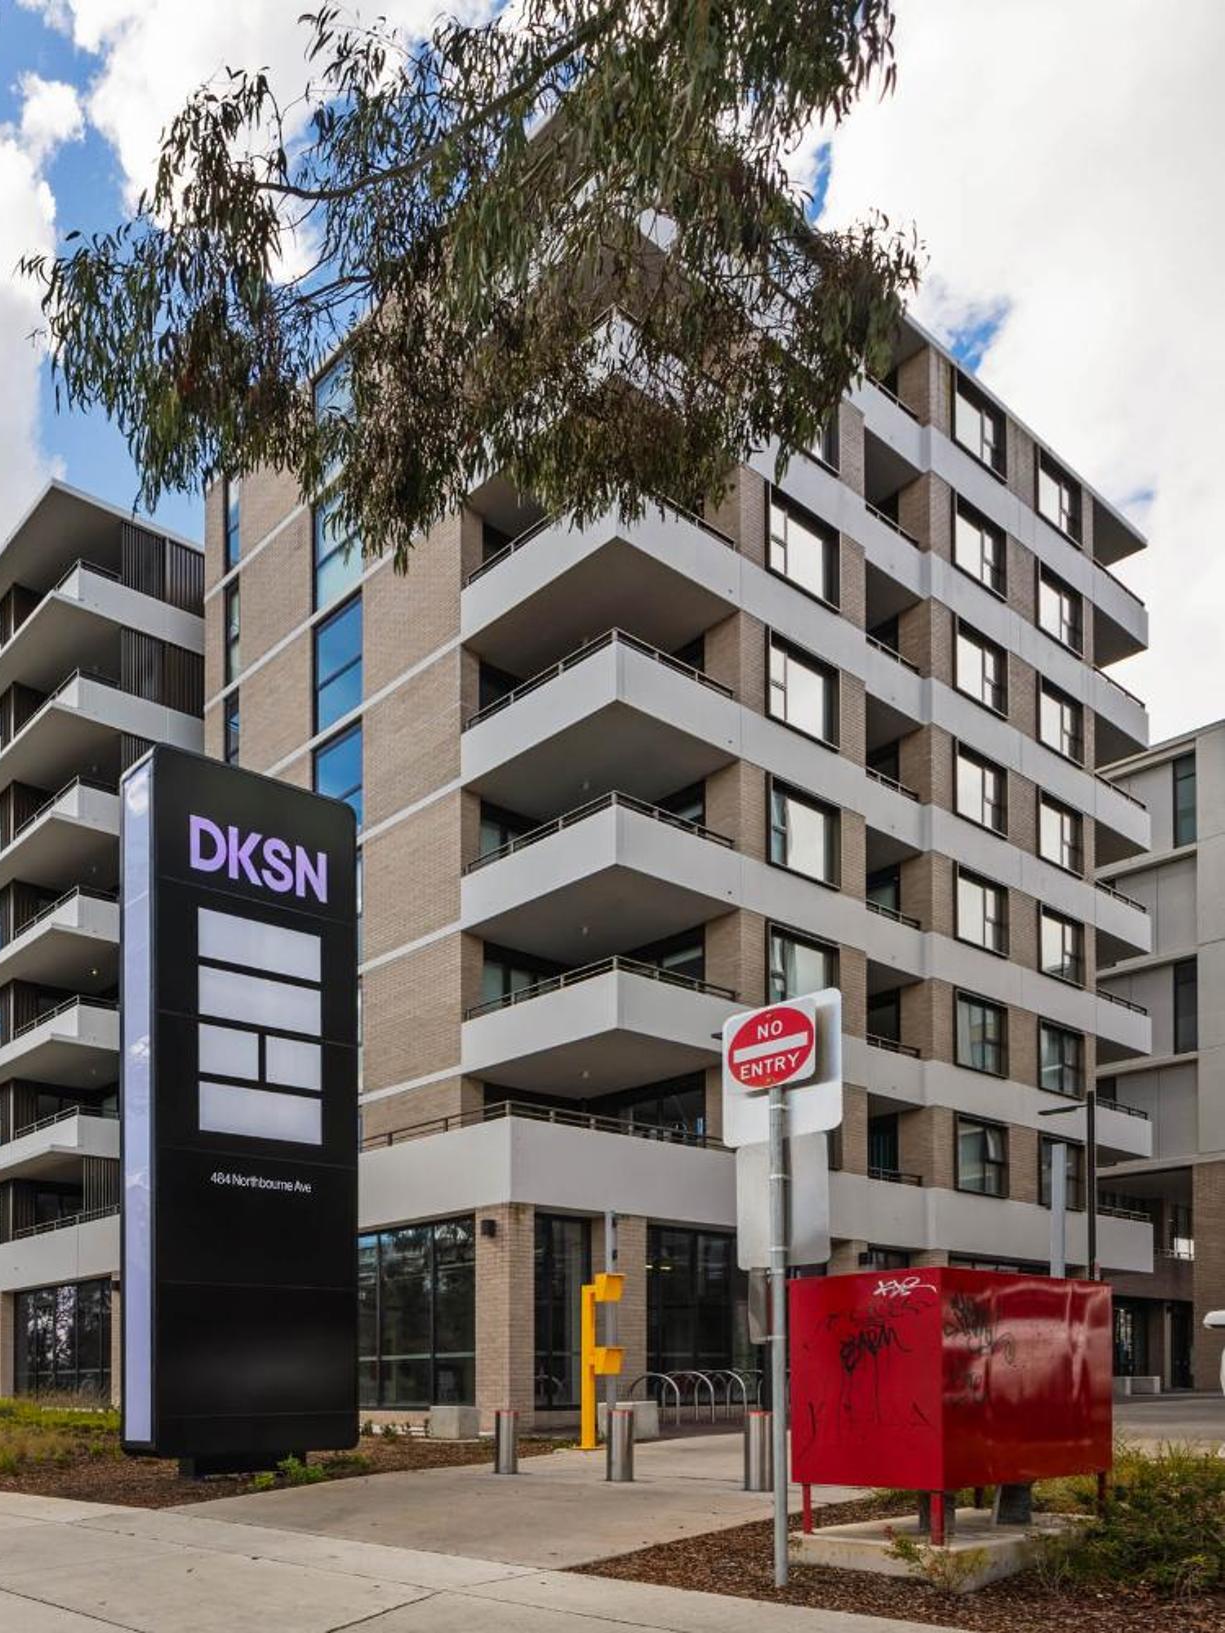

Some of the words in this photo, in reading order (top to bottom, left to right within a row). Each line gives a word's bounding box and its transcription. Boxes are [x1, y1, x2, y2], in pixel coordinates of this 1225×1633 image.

[189, 814, 328, 904] DKSN
[757, 1020, 783, 1040] NO
[740, 1051, 800, 1080] ENTRY
[210, 1172, 231, 1185] 484
[232, 1174, 293, 1191] Northbourne
[294, 1180, 312, 1193] Ave
